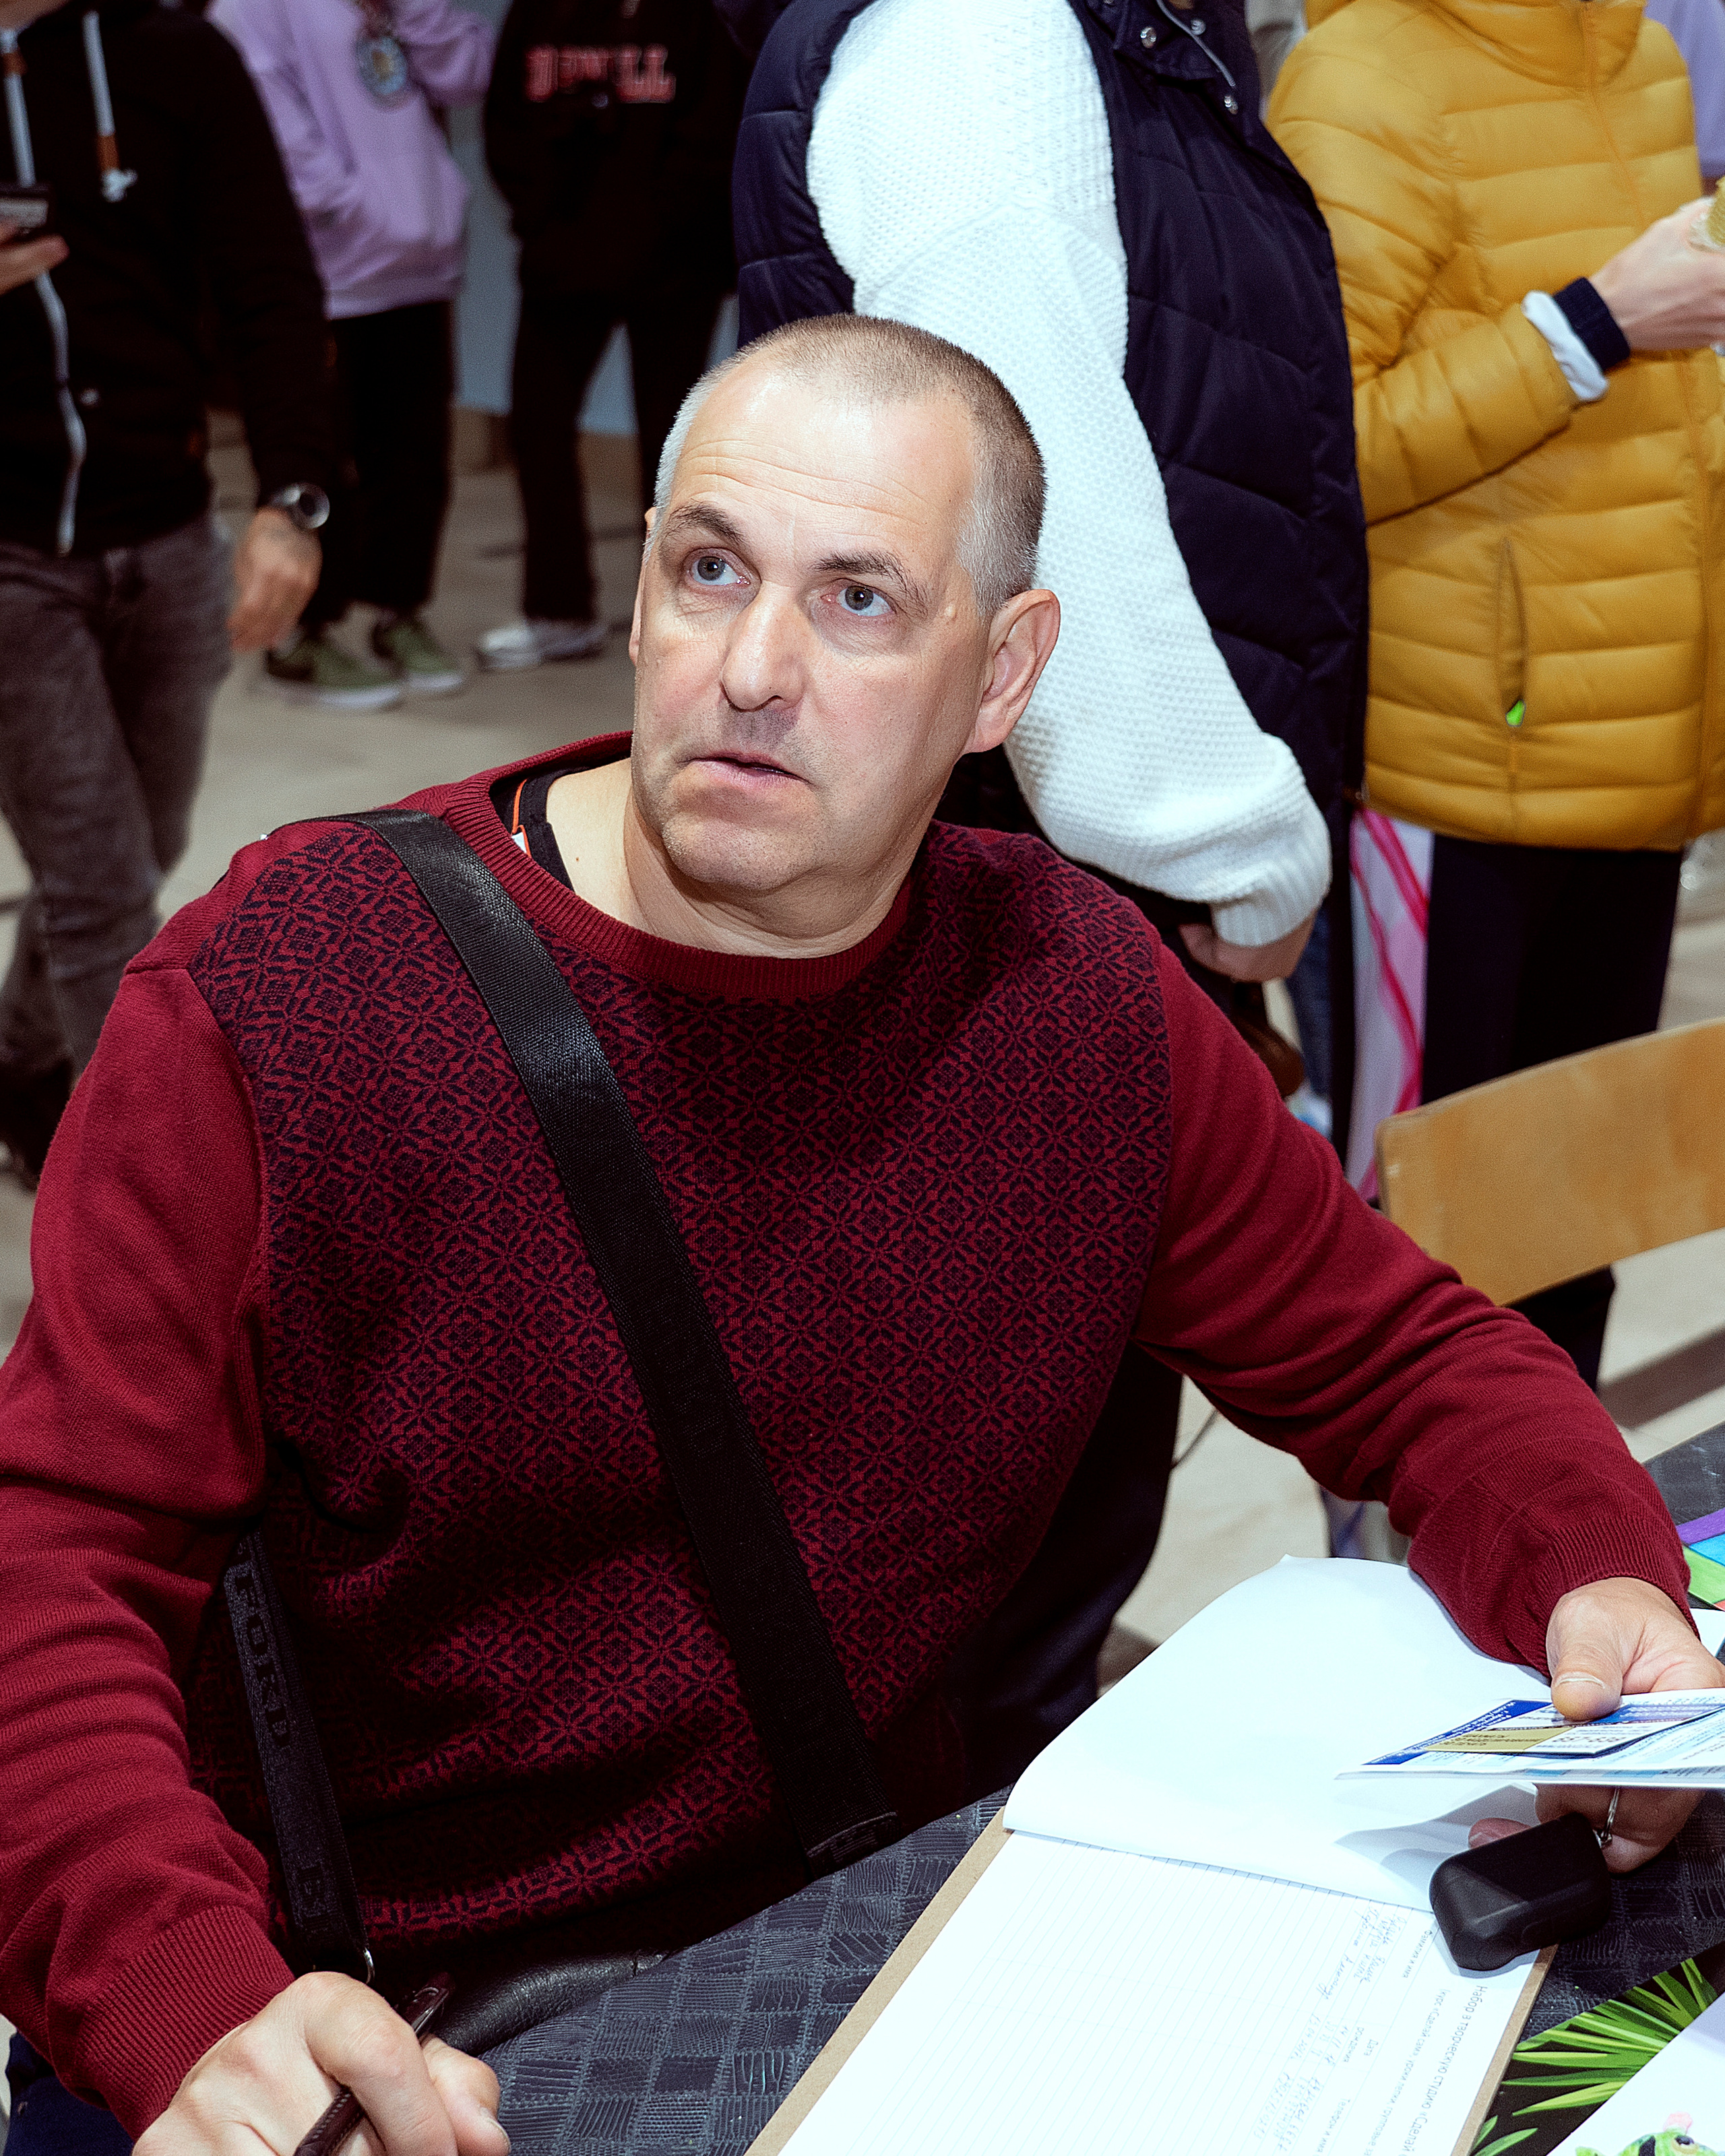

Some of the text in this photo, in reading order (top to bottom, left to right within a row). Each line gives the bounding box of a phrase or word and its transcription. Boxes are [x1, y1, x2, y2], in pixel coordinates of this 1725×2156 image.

[1414, 1930, 1432, 1958] Фамилия
[1402, 1965, 1413, 1978] имя
[1465, 1985, 1487, 2012] Набор
[1421, 2006, 1441, 2036] «Сделай
[1344, 2027, 1365, 2062] рождения
[1364, 2039, 1379, 2056] Дата
[1437, 2021, 1468, 2074] творческую
[1400, 2060, 1415, 2081] уроки
[1387, 2082, 1404, 2105] лепки,
[1421, 2074, 1443, 2109] студию
[1328, 2098, 1350, 2128] Телефон
[1369, 2107, 1392, 2146] групповые
[1316, 2138, 1328, 2153] имя
[1402, 2111, 1429, 2153] «Сделай
